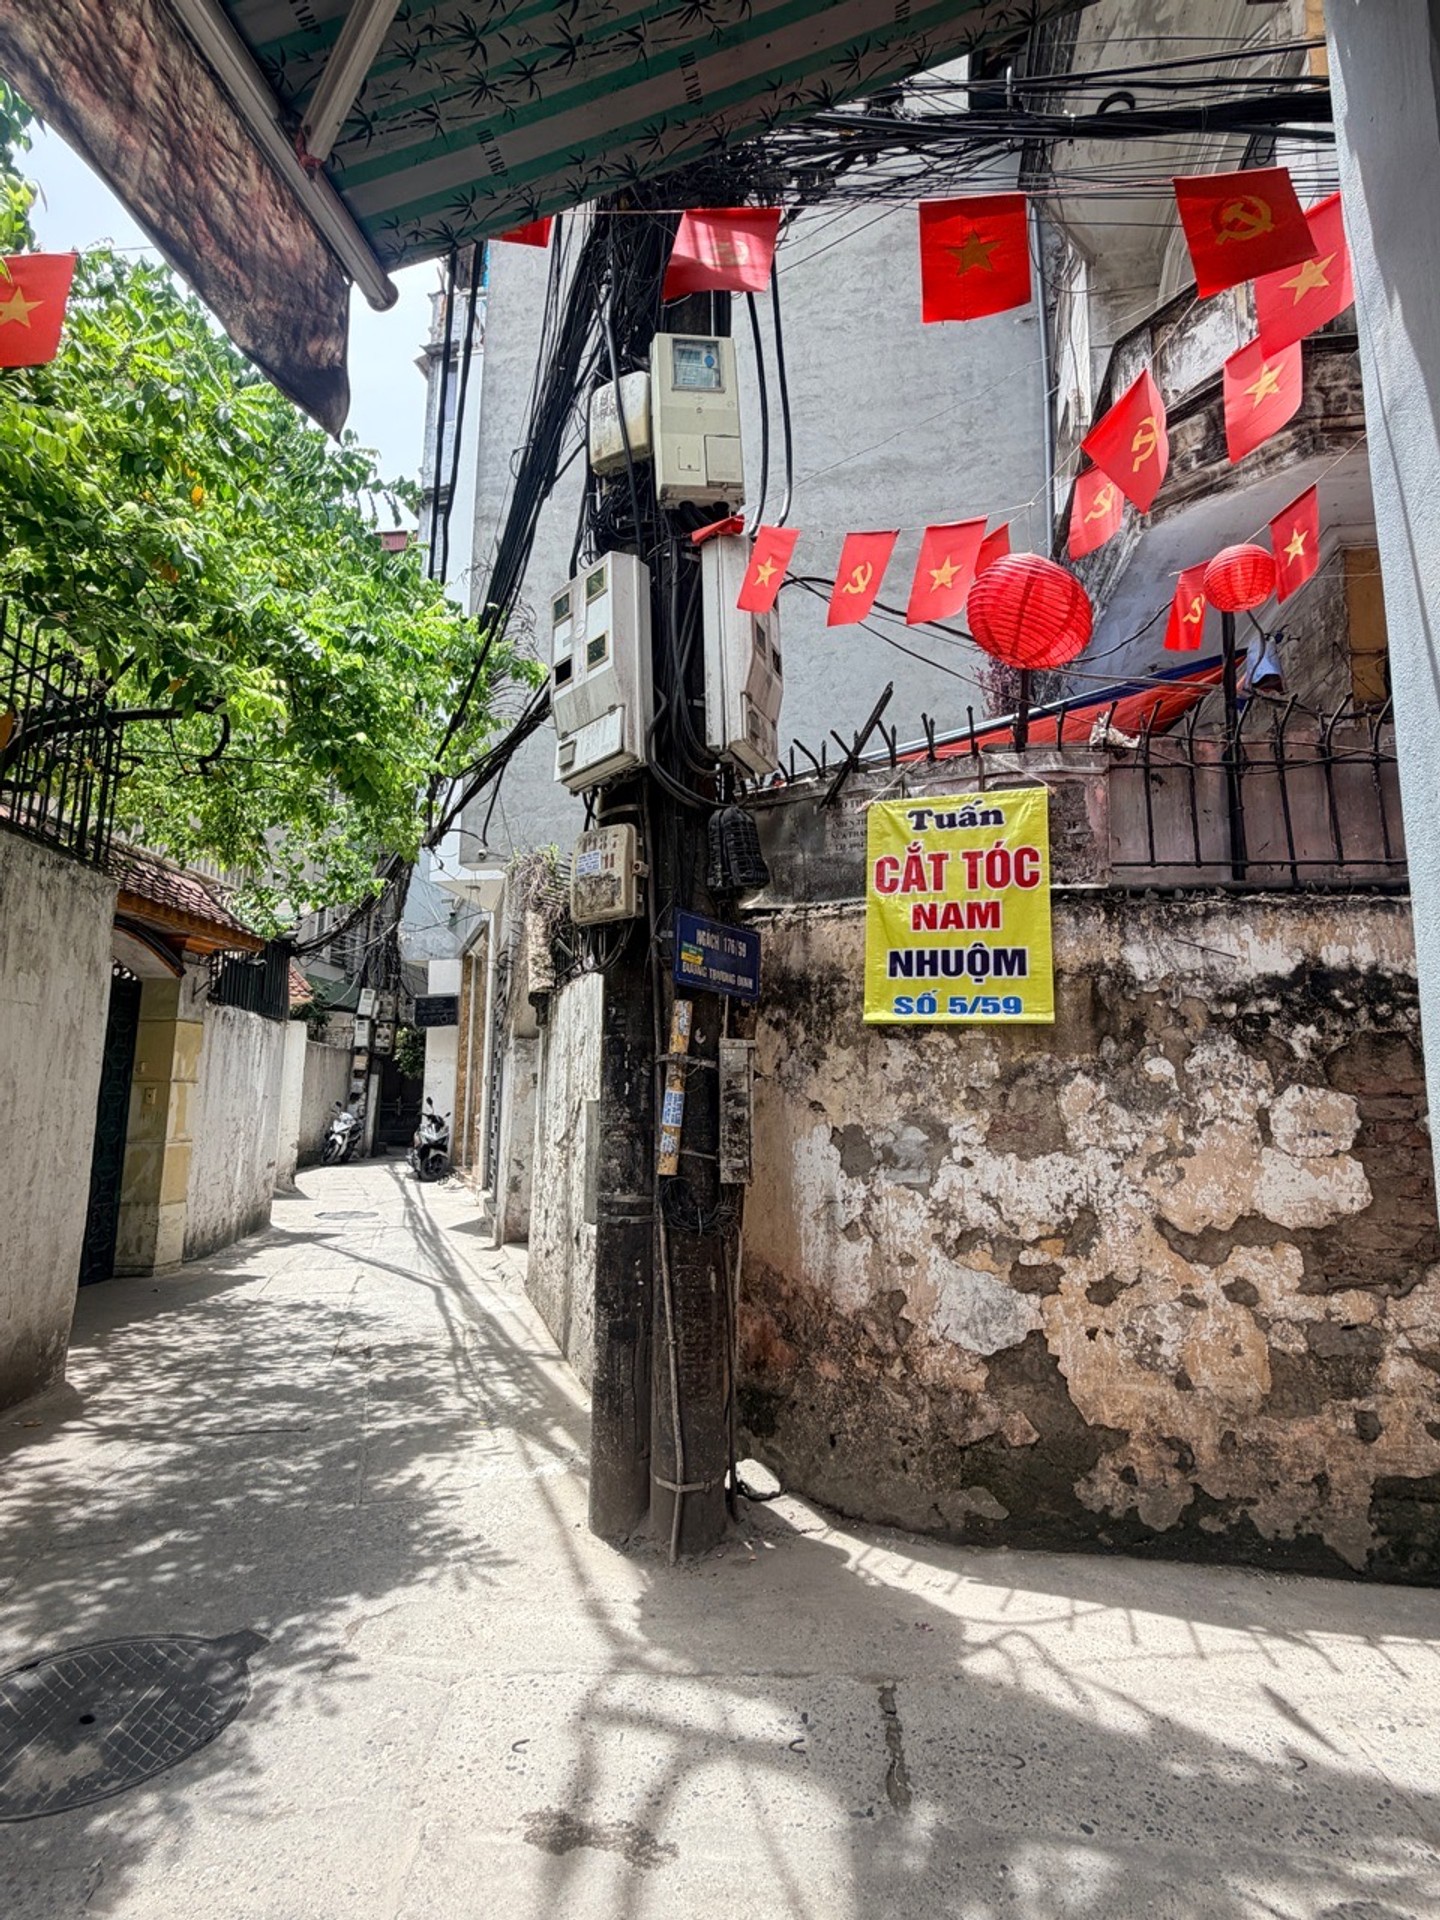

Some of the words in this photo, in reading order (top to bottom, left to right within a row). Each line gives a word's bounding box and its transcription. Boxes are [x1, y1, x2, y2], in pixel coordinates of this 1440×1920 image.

[907, 800, 1005, 831] Tuấn
[875, 840, 949, 894] CẮT
[962, 839, 1040, 891] TÓC
[911, 900, 1001, 931] NAM
[888, 942, 1027, 983] NHUỘM
[893, 989, 939, 1015] SỐ
[948, 995, 1023, 1015] 5/59
